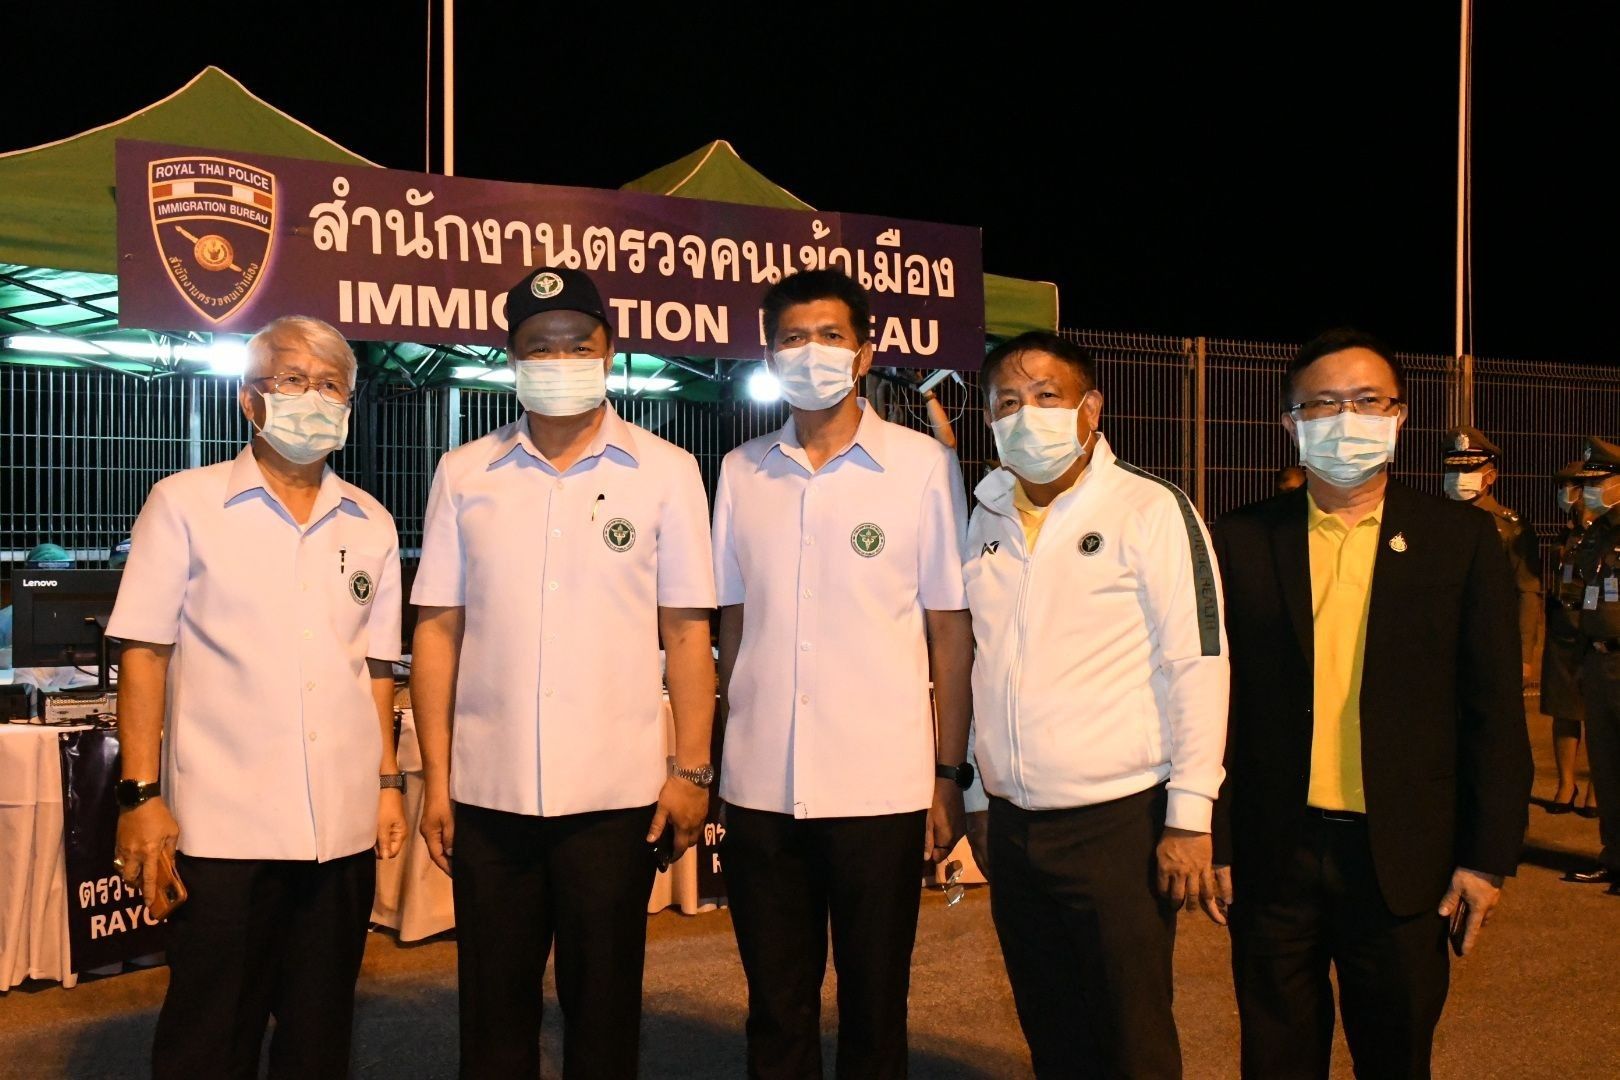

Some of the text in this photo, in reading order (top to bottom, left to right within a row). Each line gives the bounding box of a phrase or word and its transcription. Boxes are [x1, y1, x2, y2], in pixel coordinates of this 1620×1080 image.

[156, 163, 270, 190] ROYAL THAI POLICE
[158, 201, 268, 225] IMMIGRATION BUREAU
[309, 176, 955, 298] สำนักงานตรวจคนเข้าเมือง
[338, 279, 729, 344] IMMITION
[22, 579, 58, 587] Lenovo
[1200, 577, 1217, 631] HEALTH
